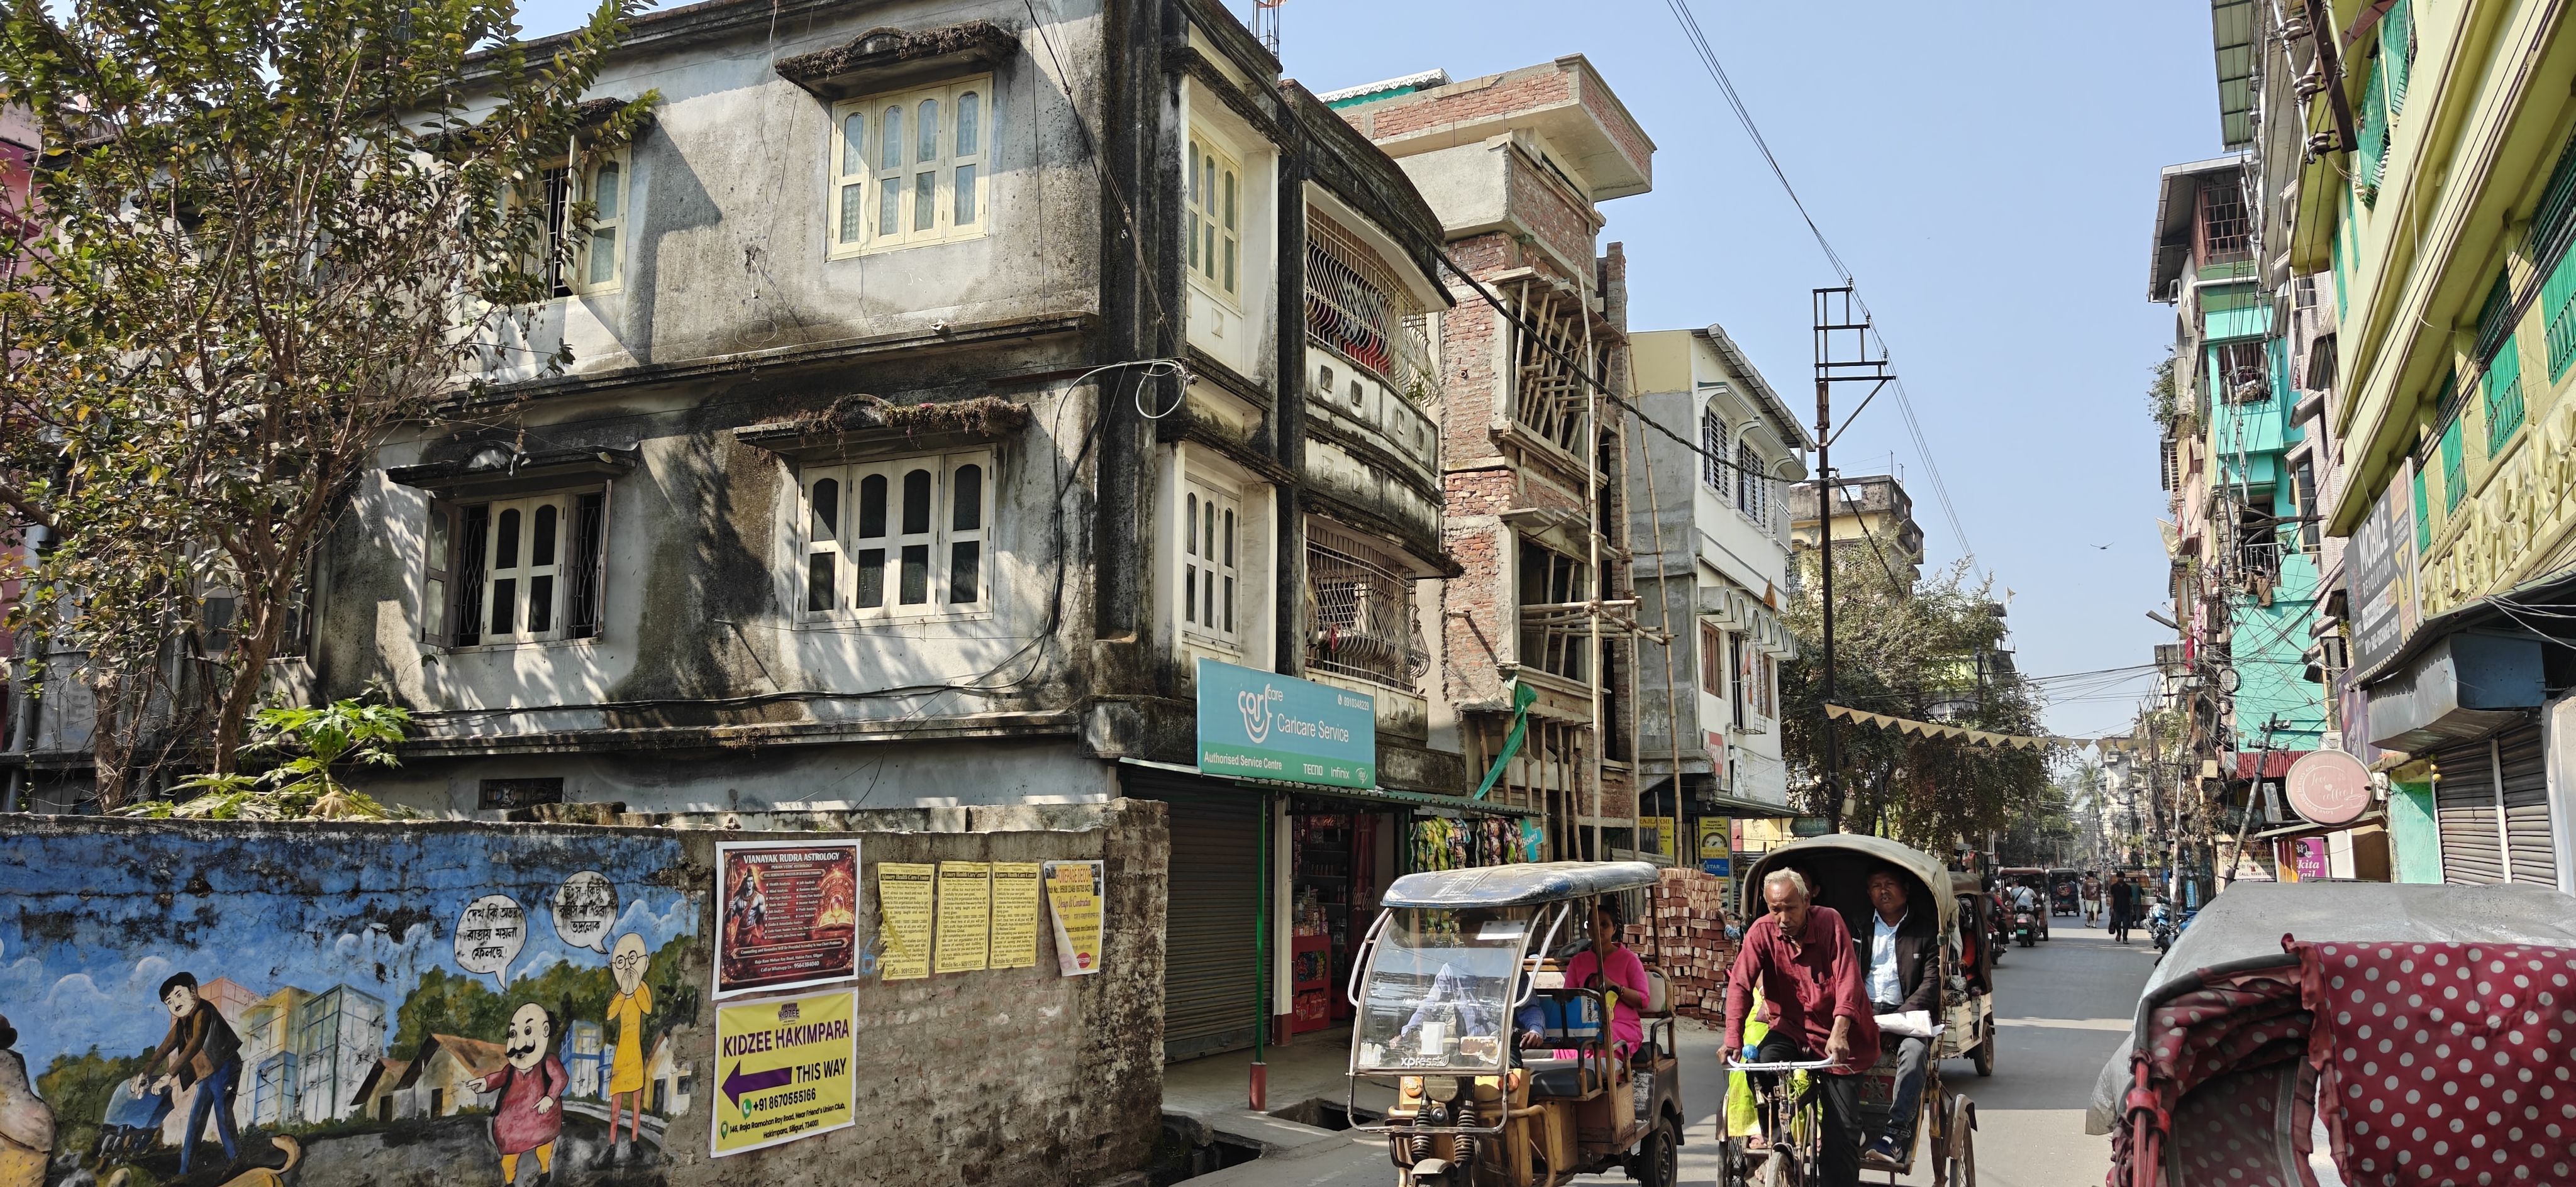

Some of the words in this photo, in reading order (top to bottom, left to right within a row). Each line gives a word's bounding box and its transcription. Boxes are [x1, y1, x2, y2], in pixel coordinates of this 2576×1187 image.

[2358, 500, 2388, 576] MOBILE
[2363, 554, 2390, 598] REVOLUTION
[1267, 688, 1283, 702] care
[1277, 713, 1316, 737] Carlcare
[1318, 720, 1348, 743] Service
[1204, 751, 1239, 766] Authorised
[1240, 755, 1262, 768] Service
[1263, 758, 1282, 770] Centre
[1303, 763, 1323, 776] TECNO
[1331, 767, 1350, 780] Infinix
[2323, 788, 2347, 802] coffee
[743, 854, 778, 864] VIANAYAK
[779, 853, 802, 863] RUDRA
[804, 852, 840, 861] ASTROLOGY
[1057, 868, 1077, 883] HOMEPAGE
[1078, 868, 1091, 883] DECOR
[467, 908, 484, 922] দেখ
[467, 929, 492, 941] রাস্তায়
[496, 927, 518, 939] ময়লা
[570, 921, 601, 933] ভদ্রলোক
[723, 1030, 772, 1057] KIDZEE
[775, 1019, 849, 1049] HAKIMPARA
[796, 1063, 821, 1084] THIS
[823, 1057, 847, 1078] WAY
[753, 1097, 767, 1111] +91
[769, 1088, 816, 1109] 8670555166
[740, 1122, 751, 1132] Raja
[783, 1113, 794, 1122] Road,
